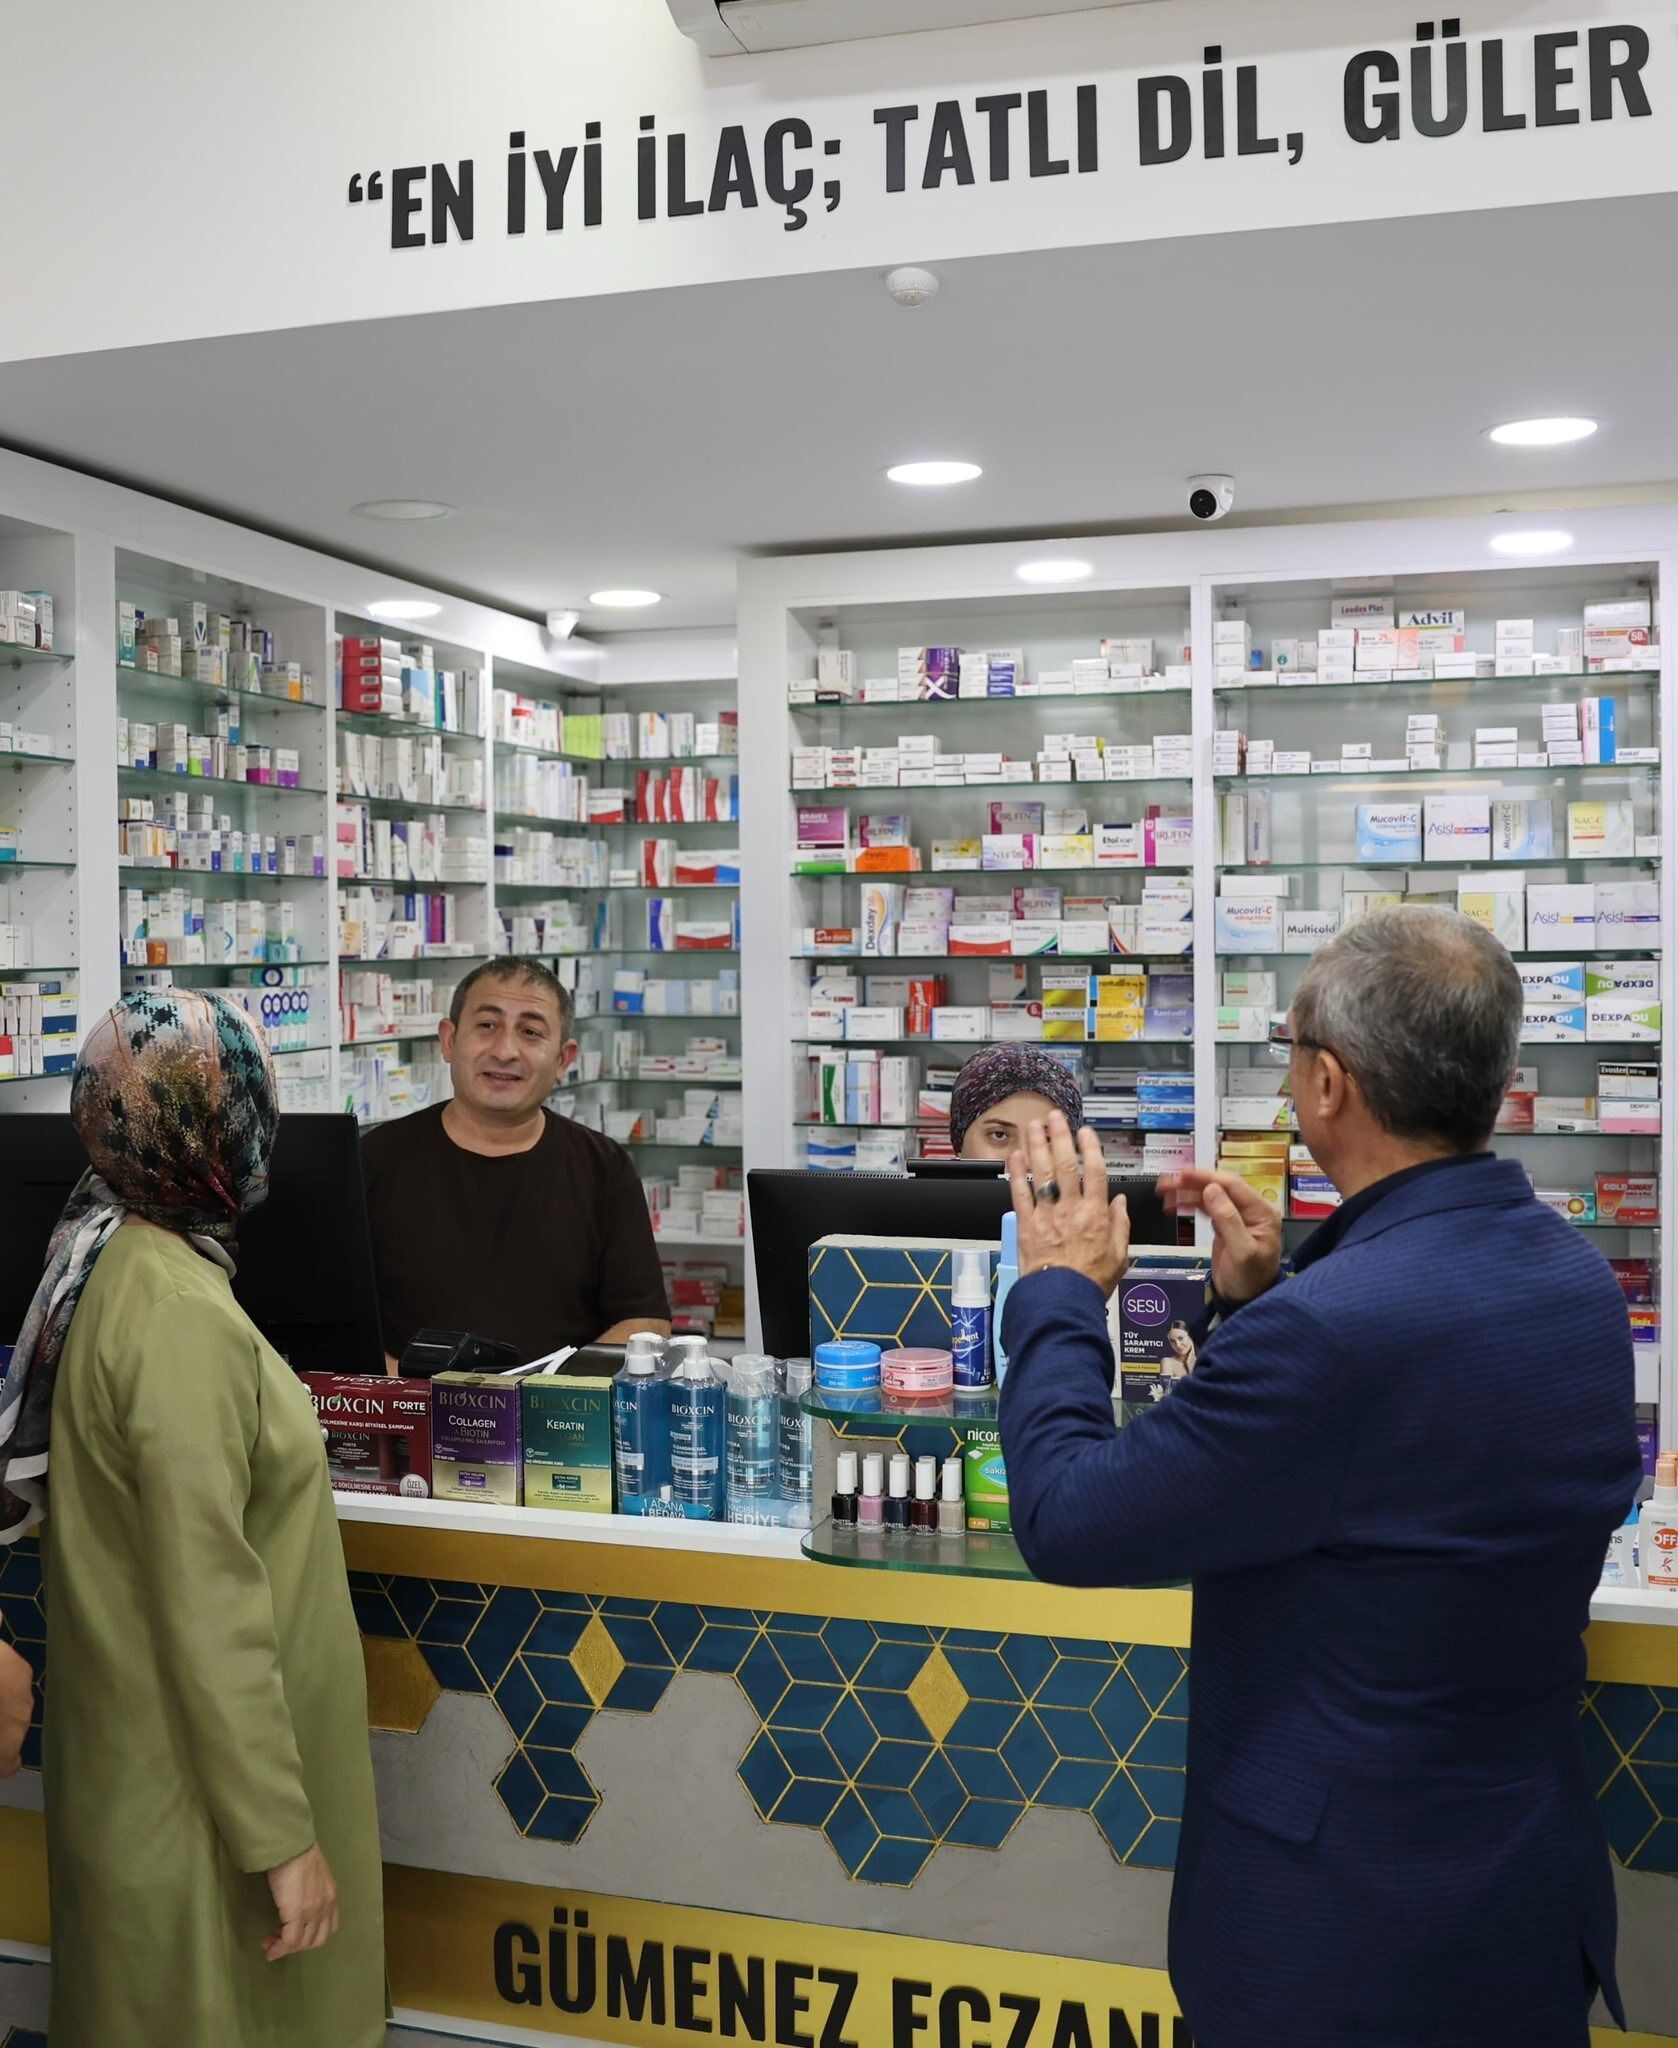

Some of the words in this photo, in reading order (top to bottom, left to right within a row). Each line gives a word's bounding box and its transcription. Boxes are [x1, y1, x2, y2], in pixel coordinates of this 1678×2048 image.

[507, 121, 602, 235] İYİ
[637, 115, 842, 231] İLAÇ;
[873, 84, 1098, 193] TATLI
[1138, 45, 1303, 165] DİL,
[1343, 18, 1653, 144] GÜLER
[1408, 611, 1453, 626] Advil
[1370, 814, 1417, 825] Mucovit-C
[1226, 906, 1272, 915] Mucovit-C
[866, 907, 878, 950] Dexday
[1287, 924, 1336, 934] Multicold
[1521, 975, 1569, 985] EXPADU
[1597, 980, 1654, 989] DEXPADU
[1591, 1013, 1649, 1022] DEXPADU
[1127, 1299, 1166, 1314] SESU
[1124, 1331, 1139, 1339] TÜY
[1124, 1340, 1163, 1348] SARARTICI
[1124, 1346, 1145, 1354] KREM
[310, 1393, 384, 1415] BIOXCIN
[393, 1401, 426, 1411] FORTE
[439, 1391, 507, 1410] BIOXCIN
[530, 1394, 600, 1412] BIXCIN
[671, 1403, 715, 1415] BIOXCIN
[388, 1423, 415, 1431] ŞAMPUAN
[448, 1415, 496, 1429] COLLAGEN
[546, 1419, 585, 1431] KERATIN
[331, 1431, 370, 1441] BIOXCIN
[460, 1427, 490, 1438] BIOTIN
[967, 1428, 1000, 1442] nicor
[475, 1438, 506, 1446] SHAMPOO
[406, 1479, 422, 1490] ÖZEL
[493, 1906, 859, 2048] GÜMENEZ
